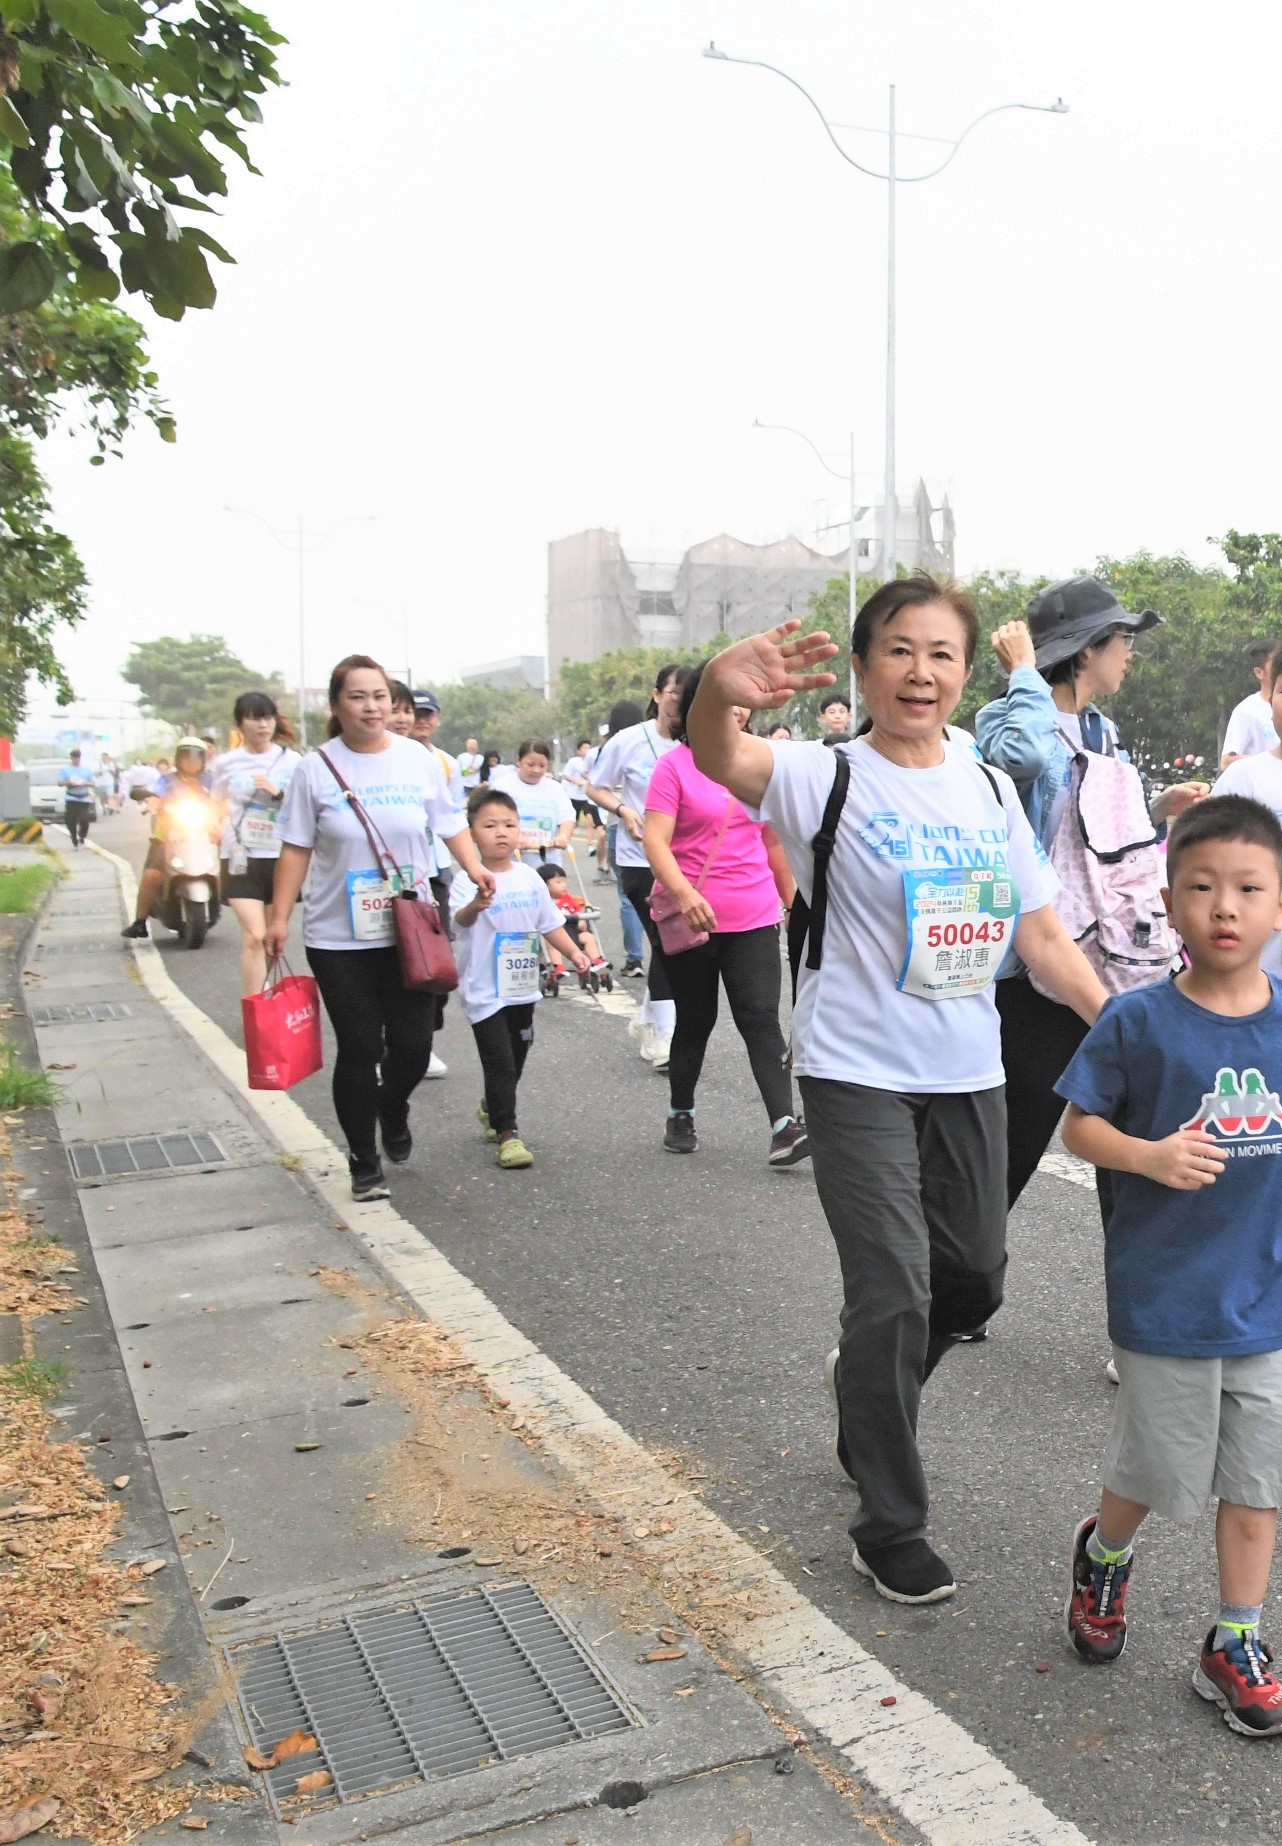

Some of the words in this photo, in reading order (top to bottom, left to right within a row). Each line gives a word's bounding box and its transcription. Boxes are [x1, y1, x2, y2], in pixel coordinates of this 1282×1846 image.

[910, 823, 975, 842] LIONS
[979, 829, 1008, 844] CU
[917, 842, 1008, 868] TAIWA
[362, 897, 394, 911] 502
[927, 920, 1005, 948] 50043
[506, 957, 539, 970] 3028
[935, 947, 991, 972] 詹淑惠
